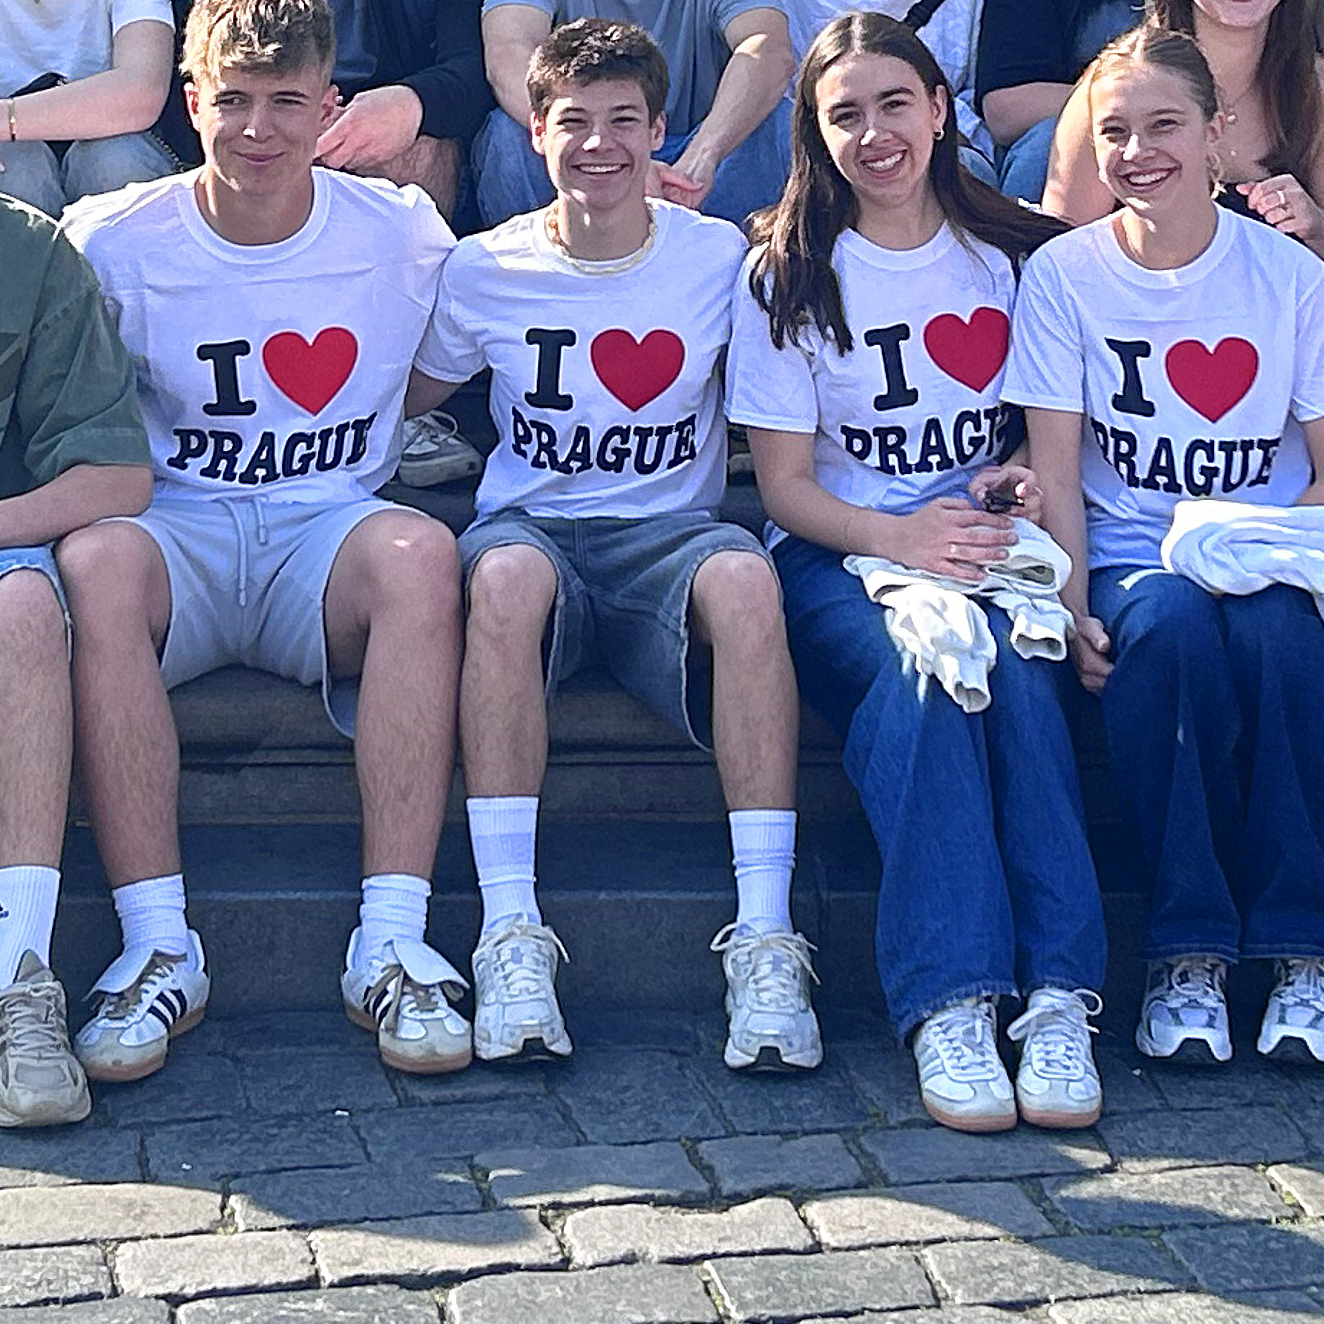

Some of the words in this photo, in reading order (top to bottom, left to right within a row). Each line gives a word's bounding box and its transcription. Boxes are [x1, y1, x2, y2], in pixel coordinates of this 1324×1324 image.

[197, 340, 257, 416] I
[524, 328, 577, 411] I
[864, 323, 919, 411] I
[1104, 337, 1156, 418] I
[512, 406, 698, 475] PRAGUE
[840, 405, 1001, 476] PRAG
